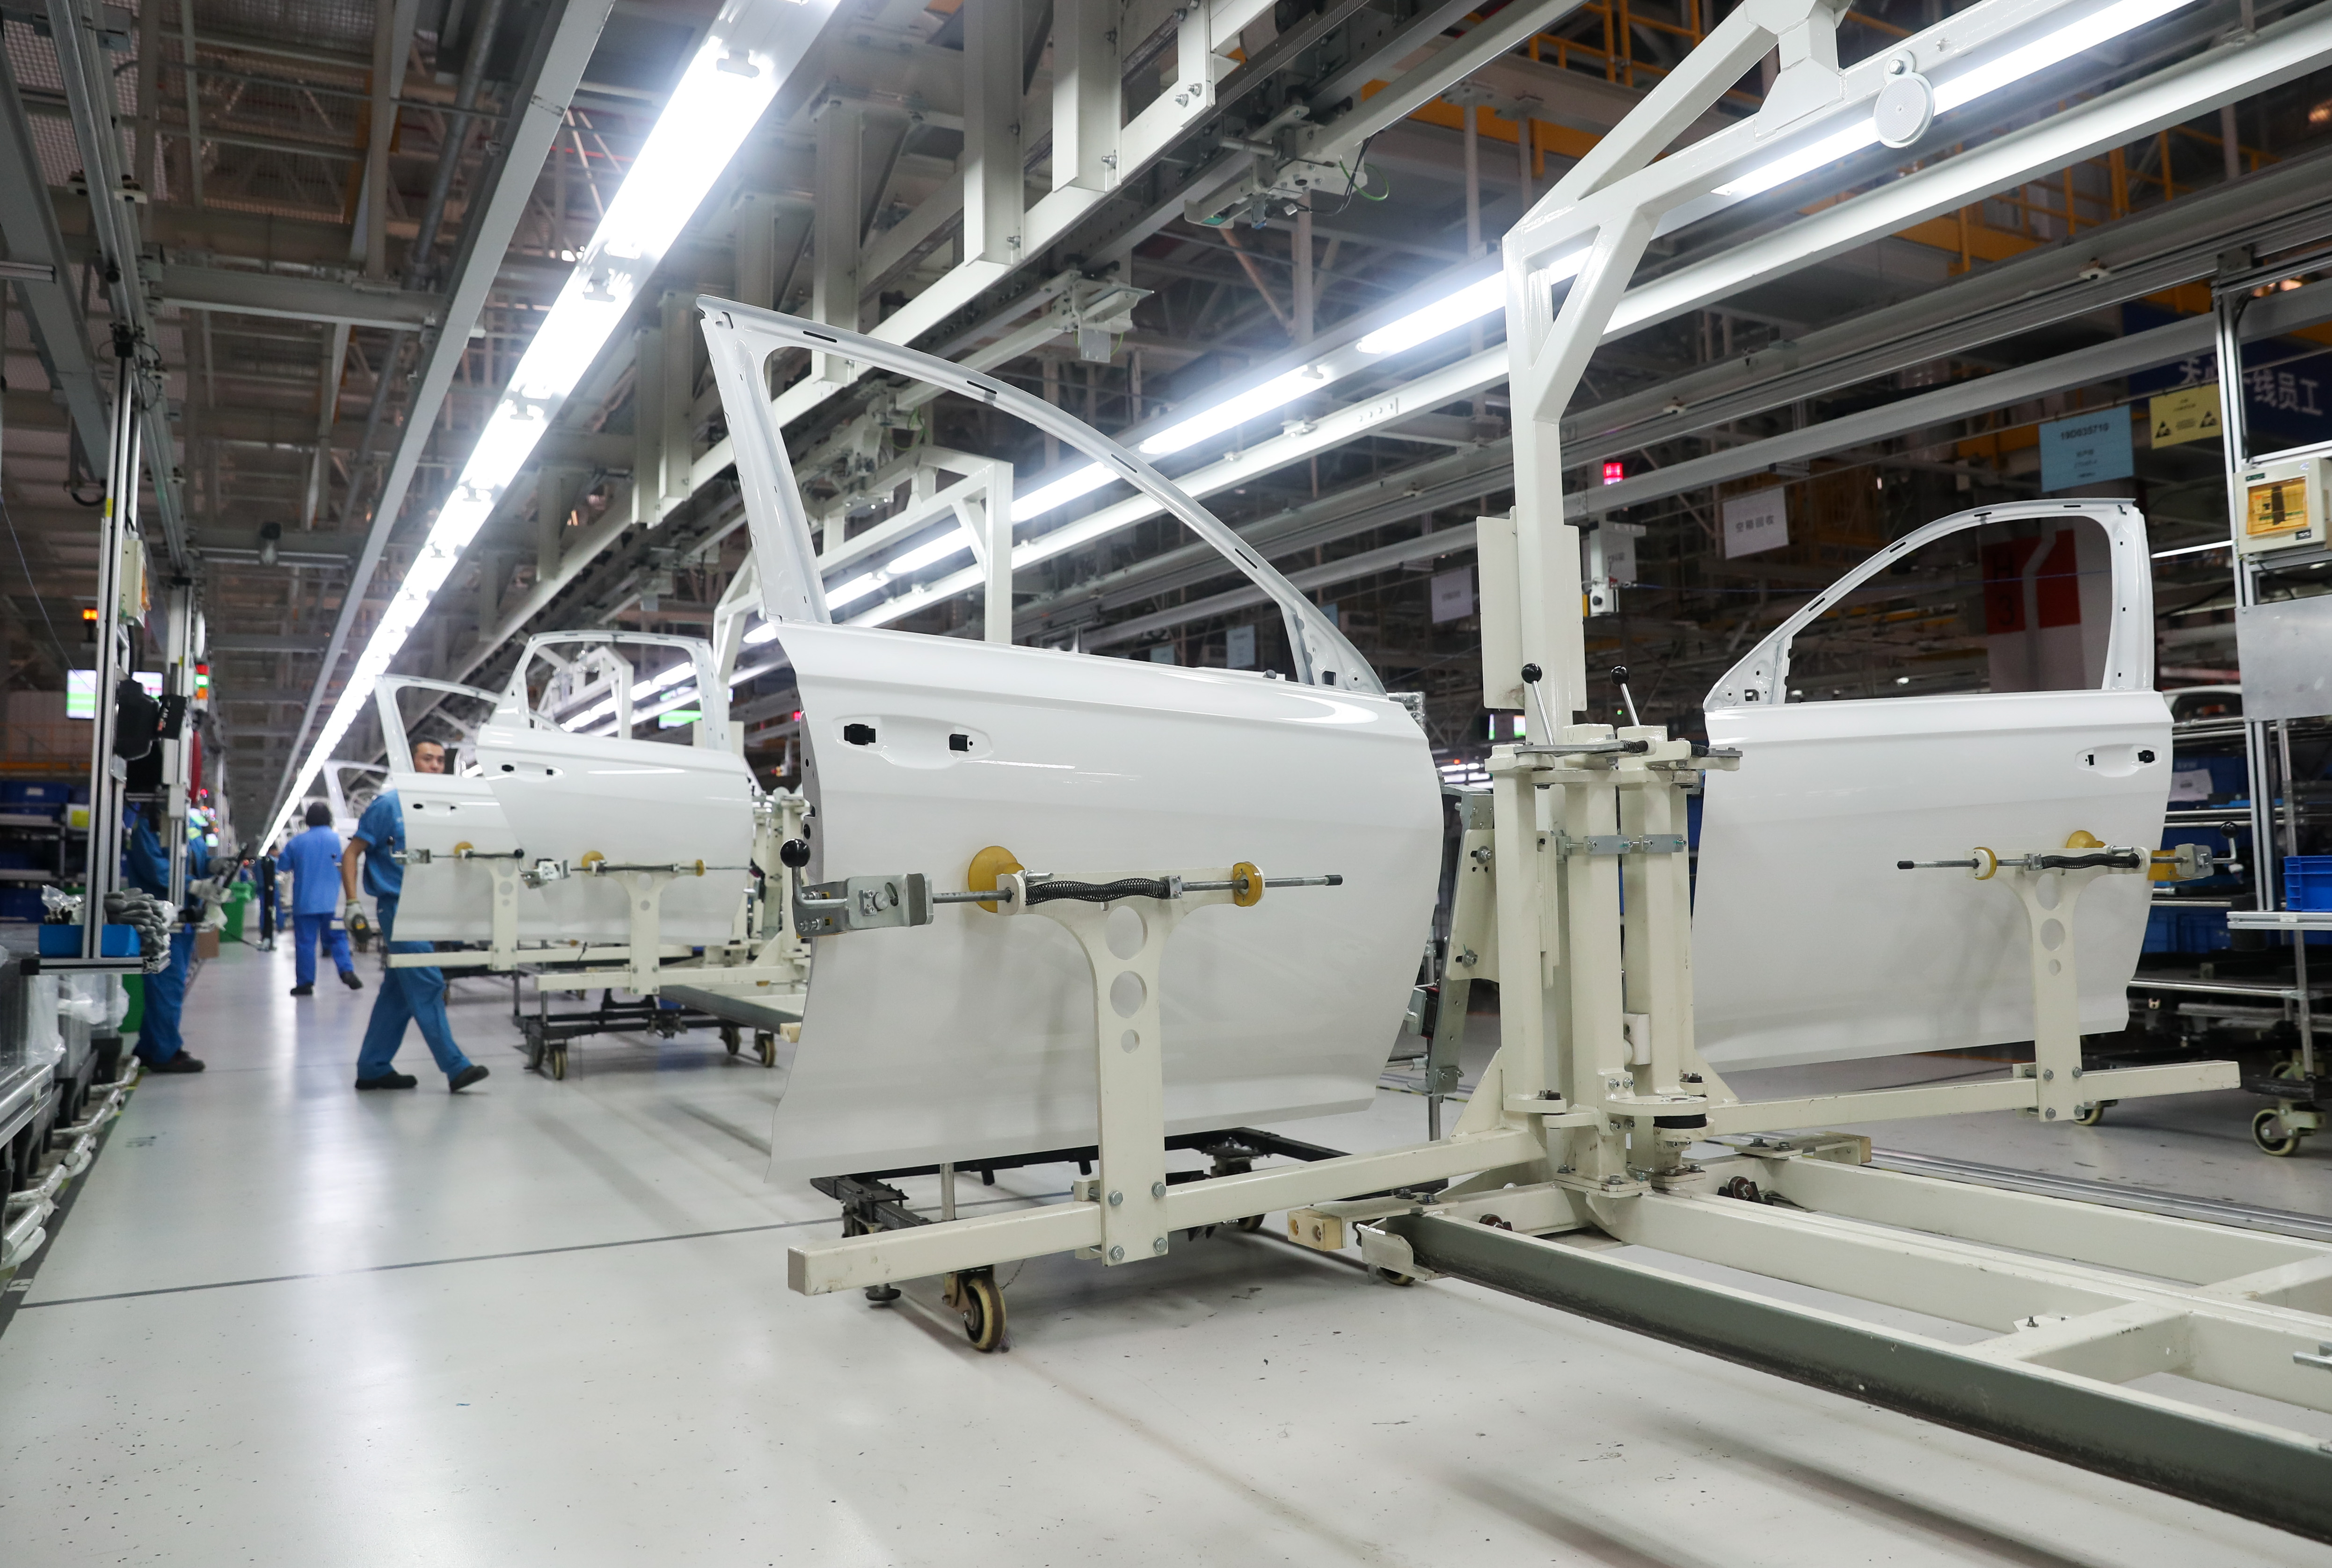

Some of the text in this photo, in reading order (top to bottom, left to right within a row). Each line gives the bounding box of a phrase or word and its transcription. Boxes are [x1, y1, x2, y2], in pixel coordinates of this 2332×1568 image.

[2179, 356, 2323, 416] 关心线员工
[1999, 594, 2015, 626] 3
